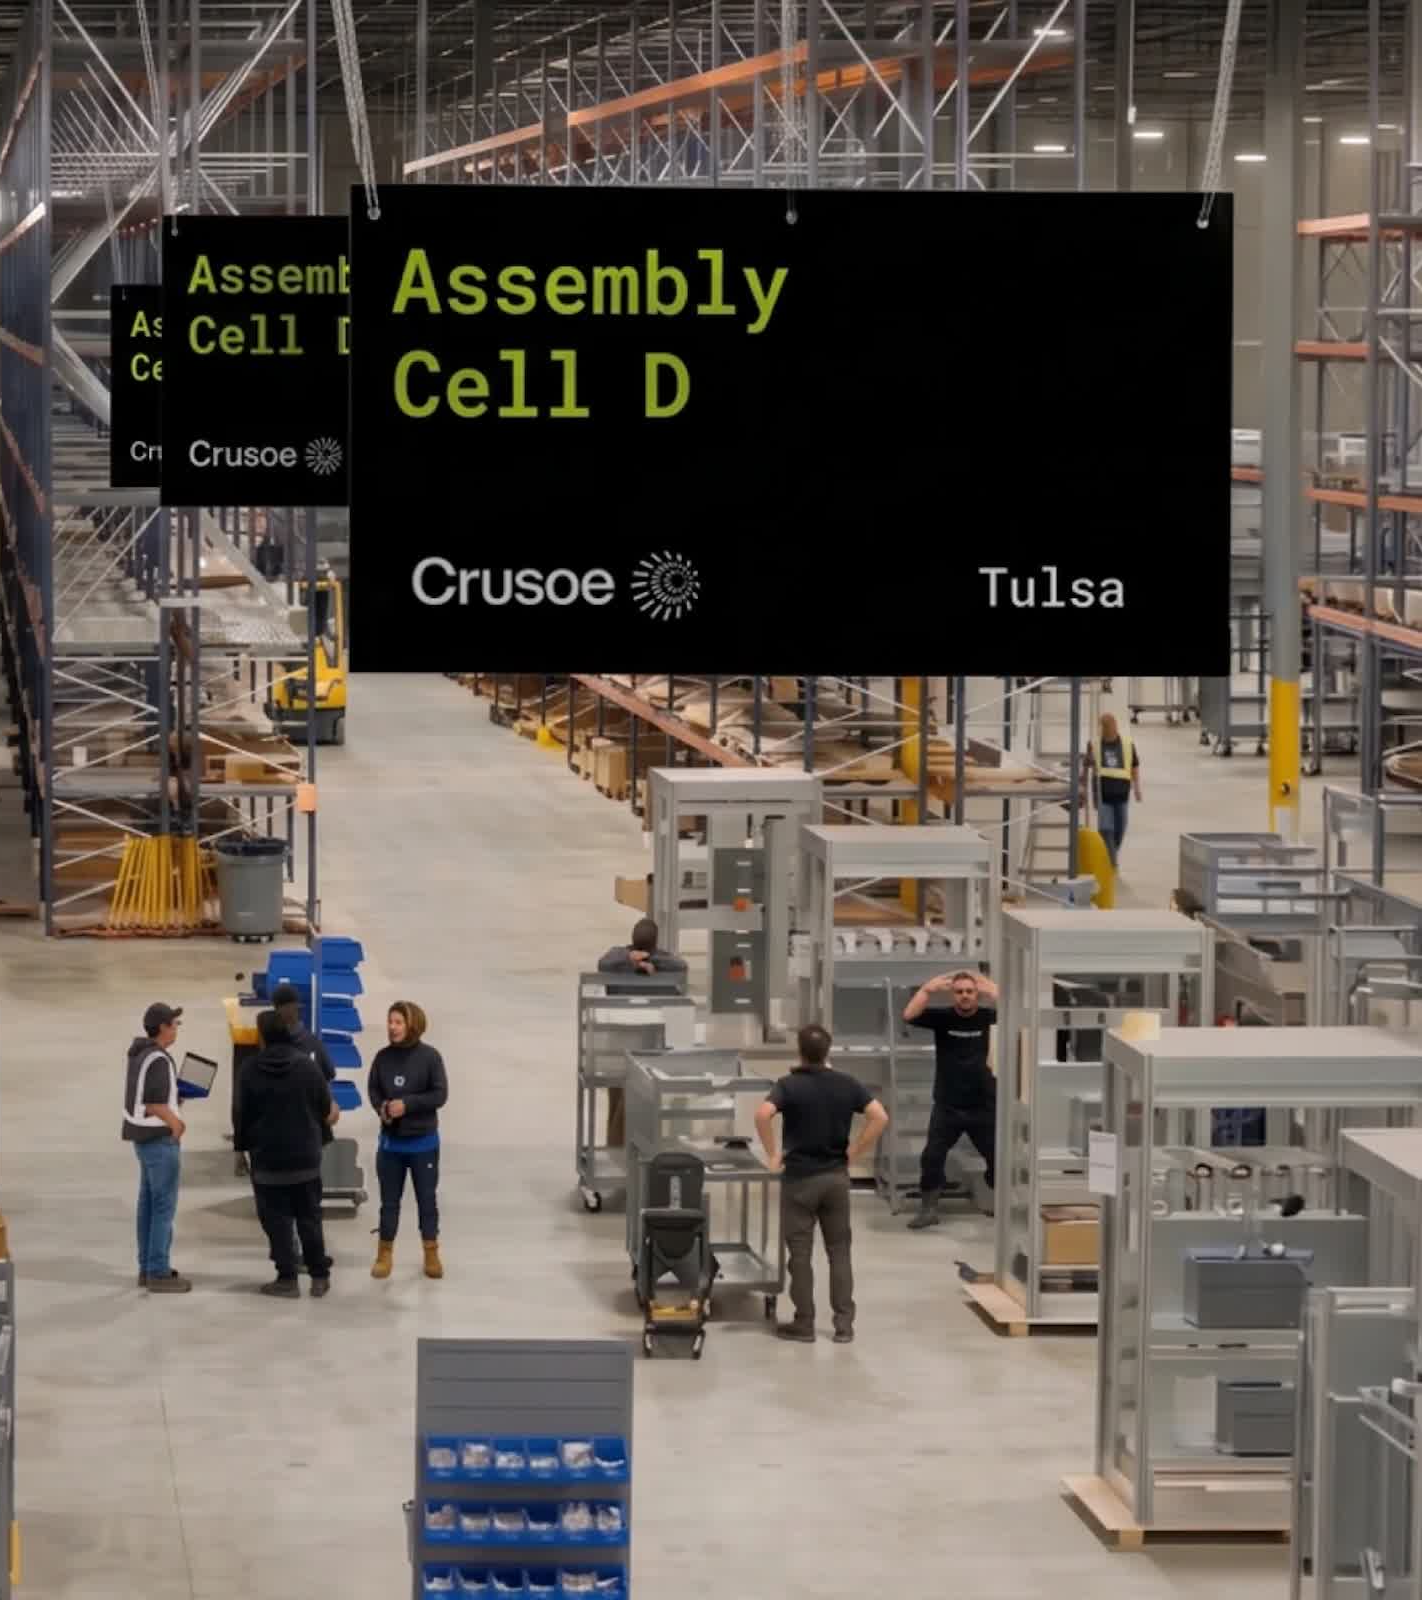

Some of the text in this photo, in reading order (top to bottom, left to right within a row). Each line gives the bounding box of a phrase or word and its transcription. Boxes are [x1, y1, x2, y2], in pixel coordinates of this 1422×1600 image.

[392, 248, 789, 334] Assembly
[189, 314, 303, 355] Cell
[394, 349, 690, 418] Cell D
[189, 439, 297, 468] Crusoe
[412, 556, 616, 606] Crusoe
[978, 565, 1125, 609] Tulsa
